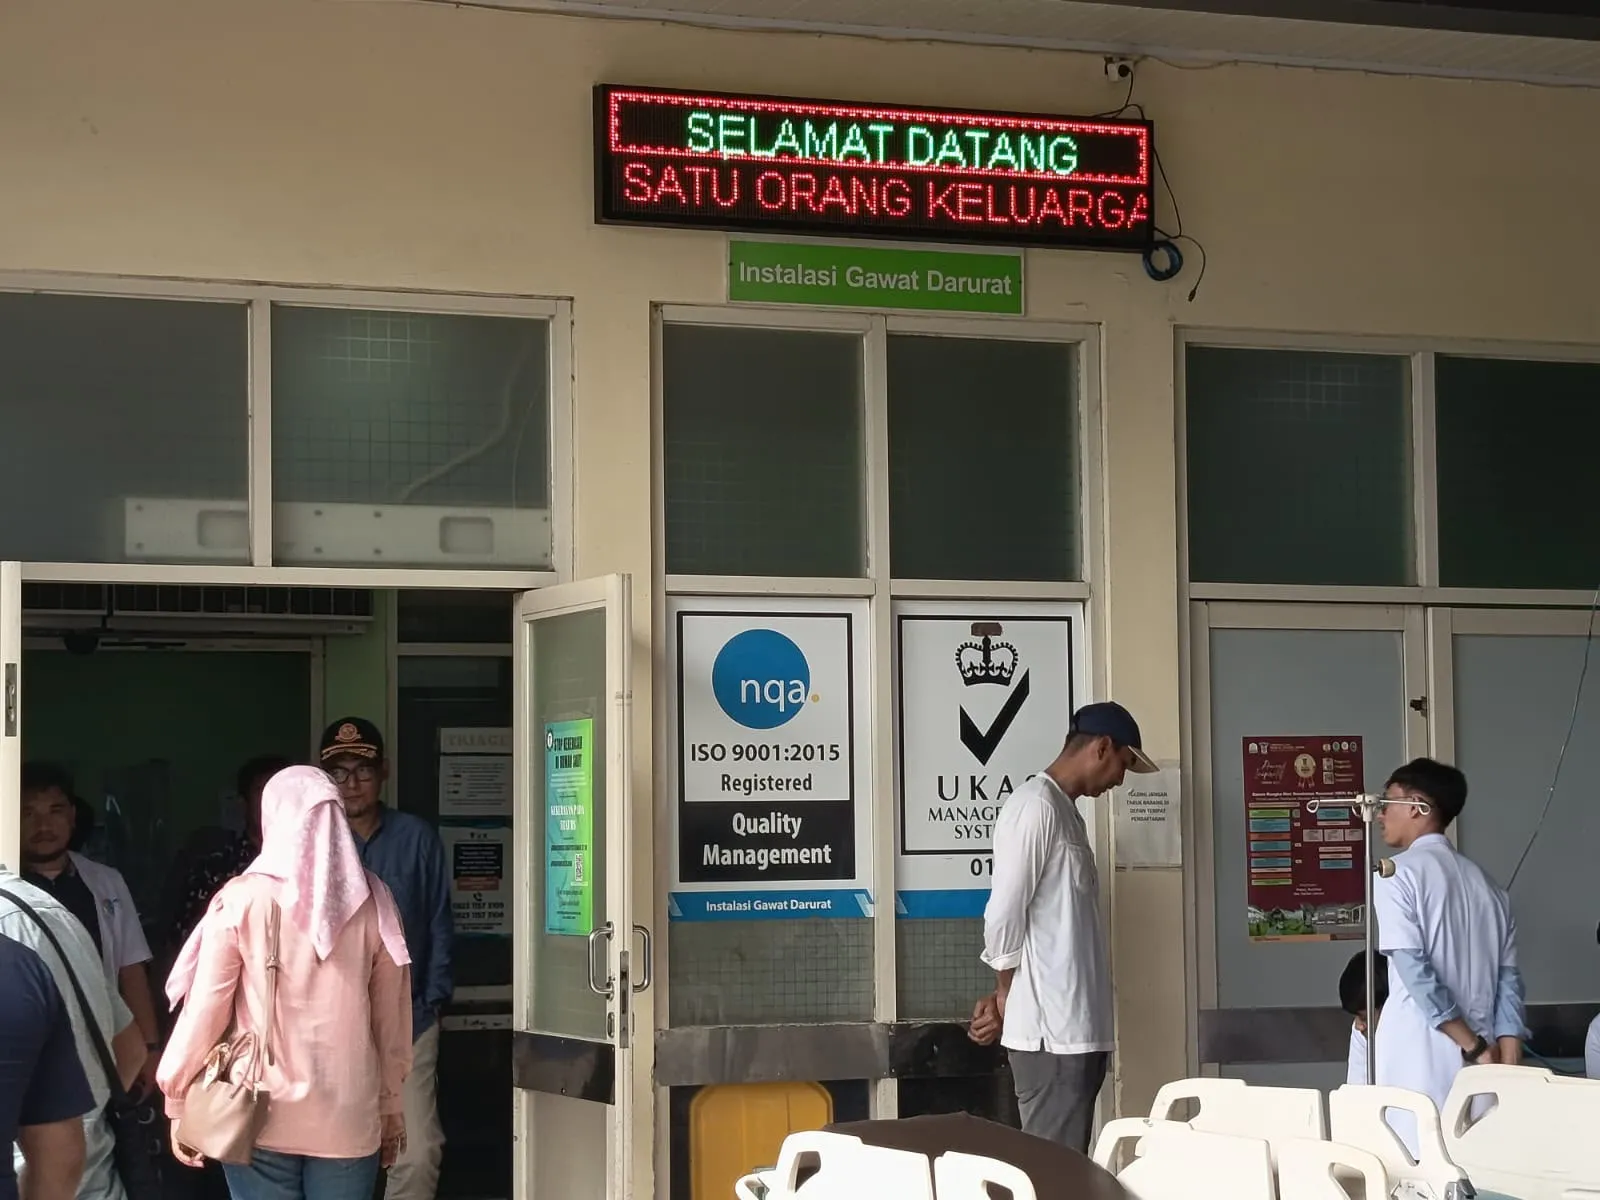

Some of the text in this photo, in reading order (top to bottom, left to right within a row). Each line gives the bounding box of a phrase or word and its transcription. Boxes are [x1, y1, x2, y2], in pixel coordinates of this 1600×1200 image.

[687, 111, 1078, 176] SELAMAT DATANG
[624, 162, 739, 208] SATU
[755, 170, 912, 217] ORANG
[739, 261, 1013, 296] Instalasi Gawat Darurat
[691, 743, 841, 762] ISO 9001:2015
[721, 773, 813, 796] Registered
[937, 774, 1037, 802] UKA
[732, 811, 802, 839] Quality
[703, 843, 832, 871] Management
[706, 899, 832, 912] Instalasi Gawat Darurat
